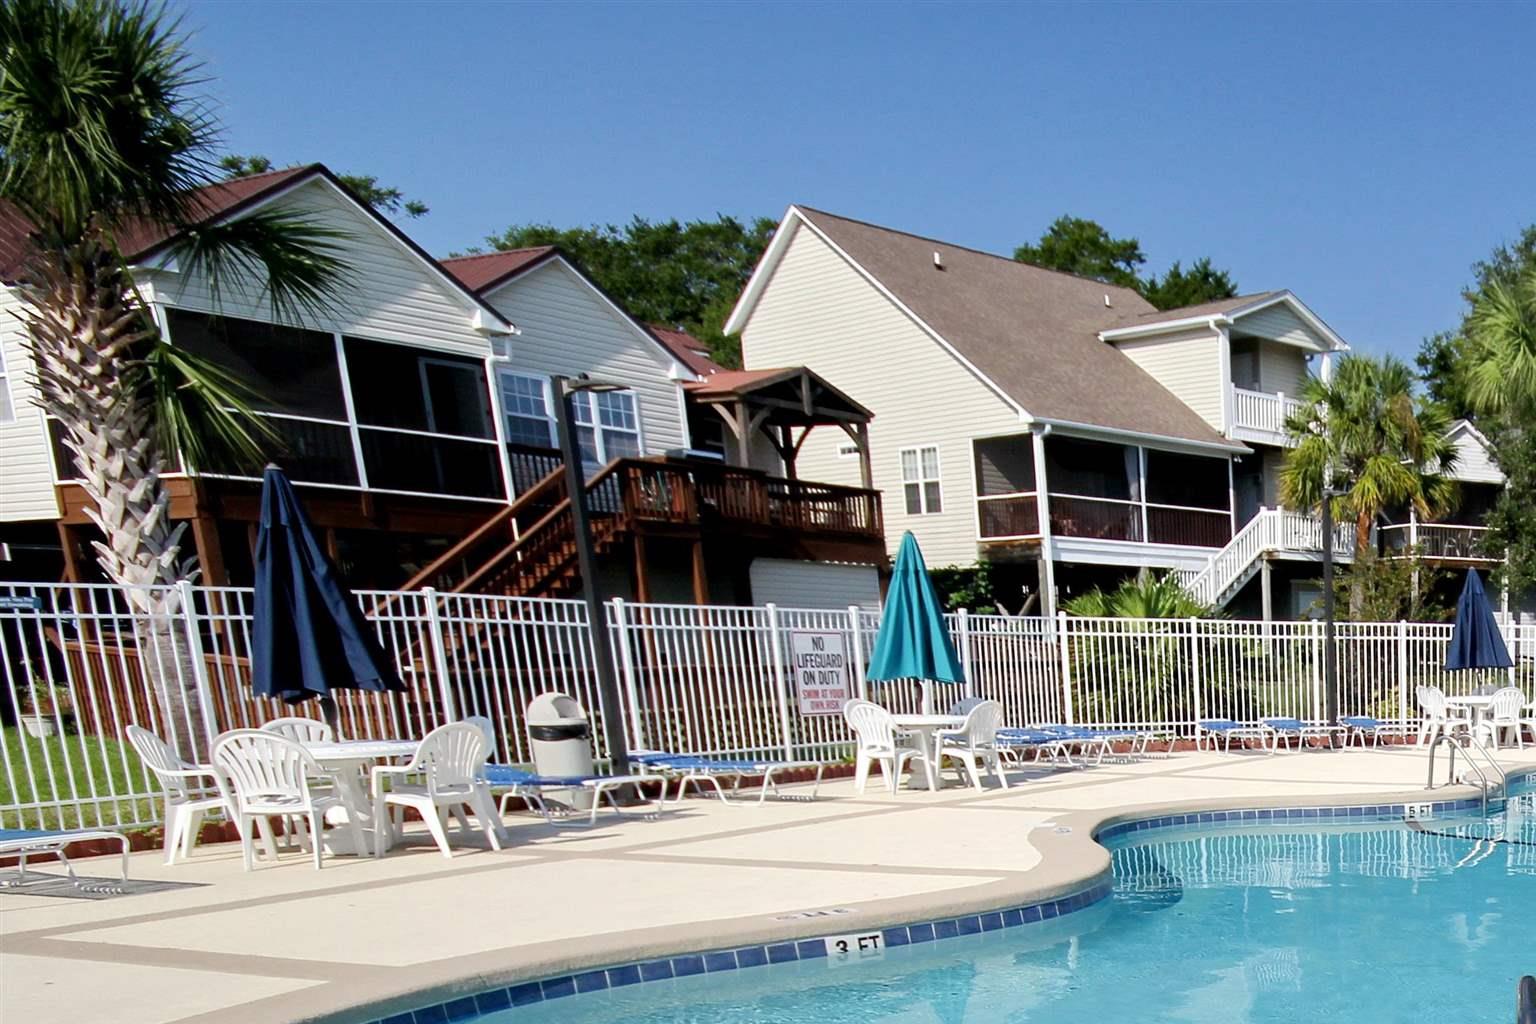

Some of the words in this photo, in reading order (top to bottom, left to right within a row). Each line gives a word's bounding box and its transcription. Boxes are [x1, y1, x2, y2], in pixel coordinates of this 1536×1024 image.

[812, 637, 825, 651] NO
[797, 653, 843, 669] LIFEGUARD
[803, 671, 815, 685] ON
[818, 670, 840, 685] DUTY
[802, 689, 819, 699] SWIM
[821, 689, 828, 698] AT
[829, 688, 845, 698] YOUR
[1420, 805, 1430, 816] FT
[835, 940, 849, 954] 3
[857, 935, 880, 951] FT
